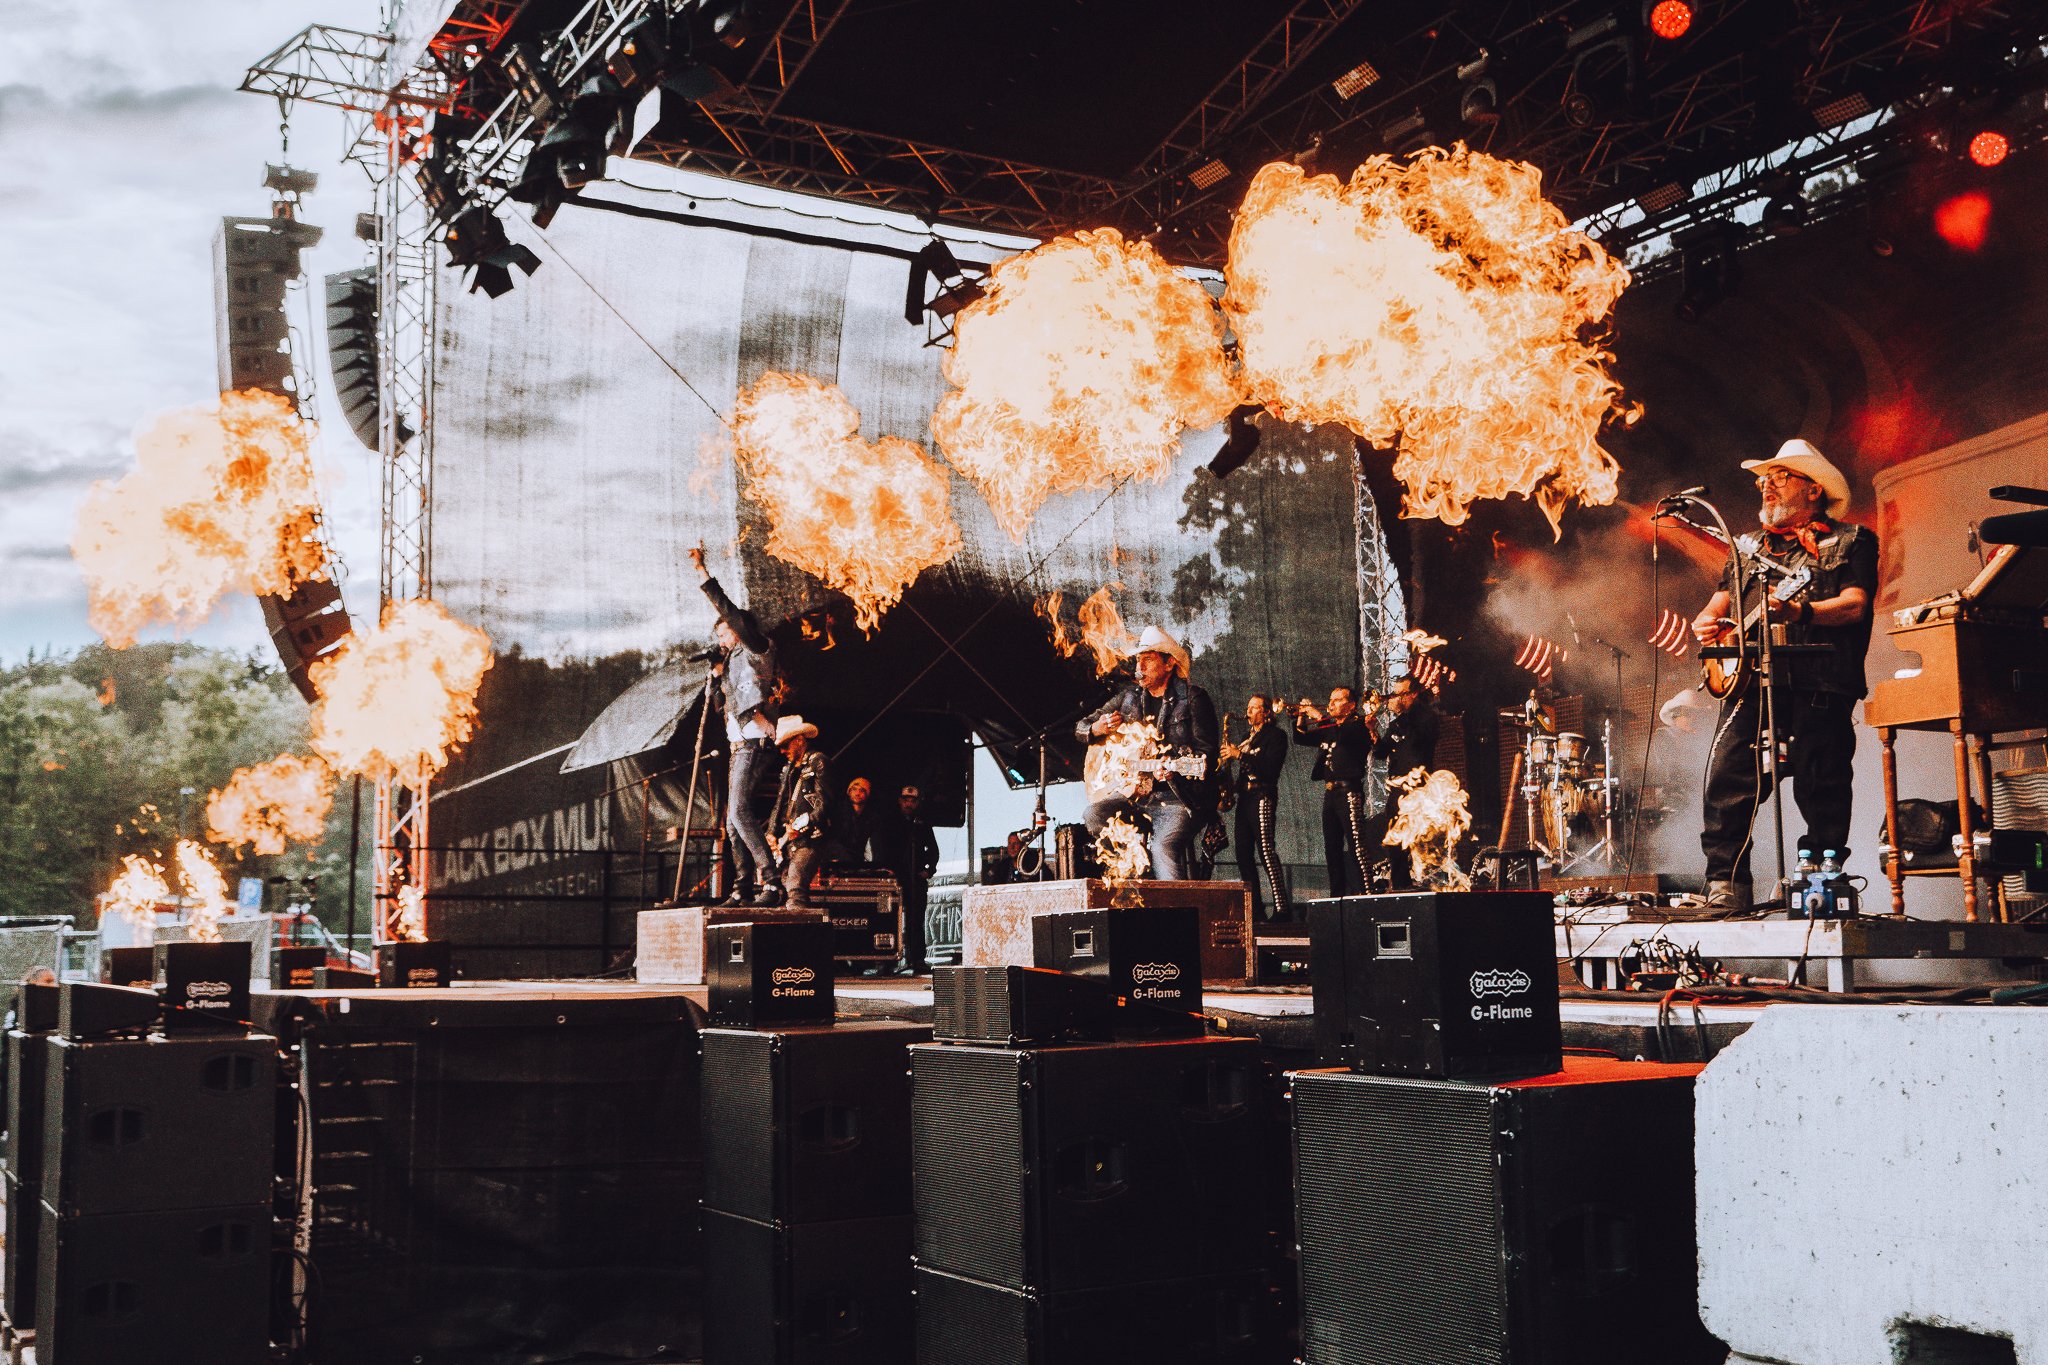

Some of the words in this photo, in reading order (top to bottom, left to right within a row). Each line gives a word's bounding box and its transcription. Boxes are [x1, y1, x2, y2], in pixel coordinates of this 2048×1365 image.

[494, 814, 549, 876] BOX
[830, 918, 868, 926] ECKER
[772, 987, 815, 997] G-Flame
[1133, 988, 1181, 999] G-Flame
[1470, 1004, 1532, 1021] G-Flame
